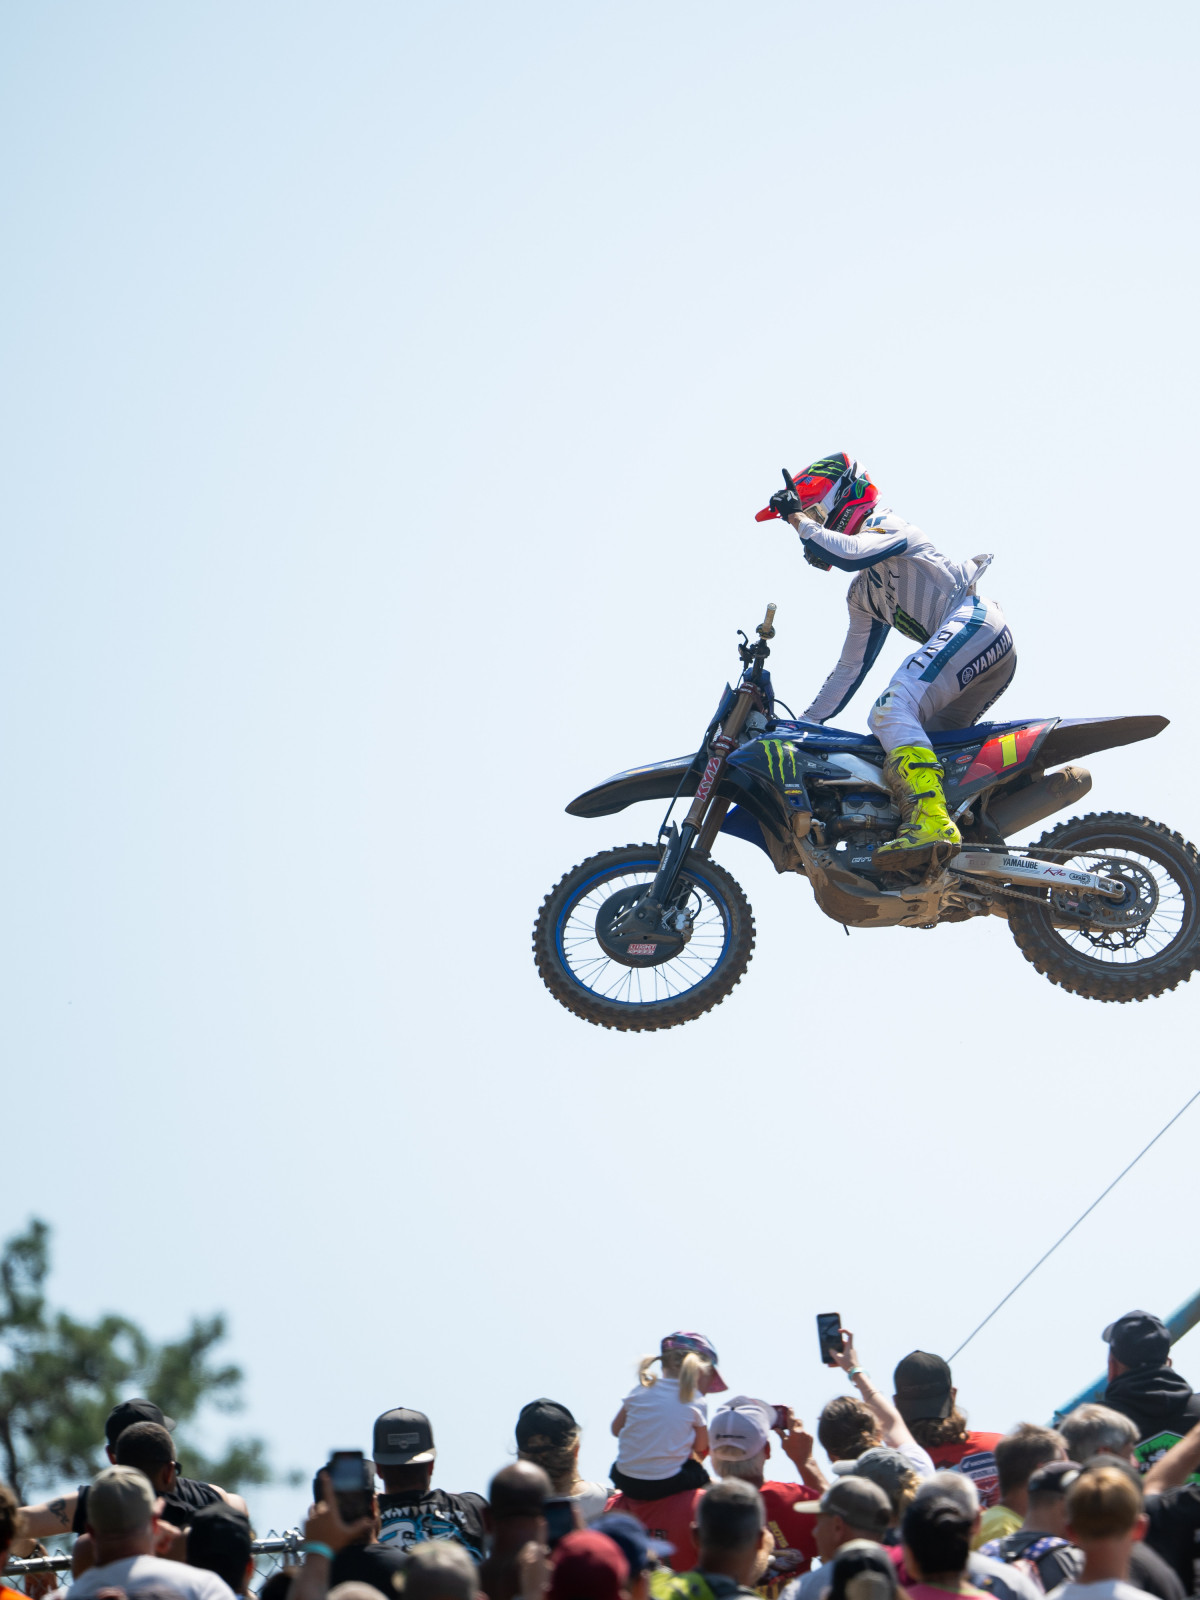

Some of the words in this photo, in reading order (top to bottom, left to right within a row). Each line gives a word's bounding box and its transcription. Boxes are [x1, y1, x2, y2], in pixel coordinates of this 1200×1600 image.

[972, 630, 1013, 674] YAMAHA
[998, 733, 1018, 768] 1
[695, 757, 721, 802] KYB
[1003, 857, 1039, 870] YAMALUBE
